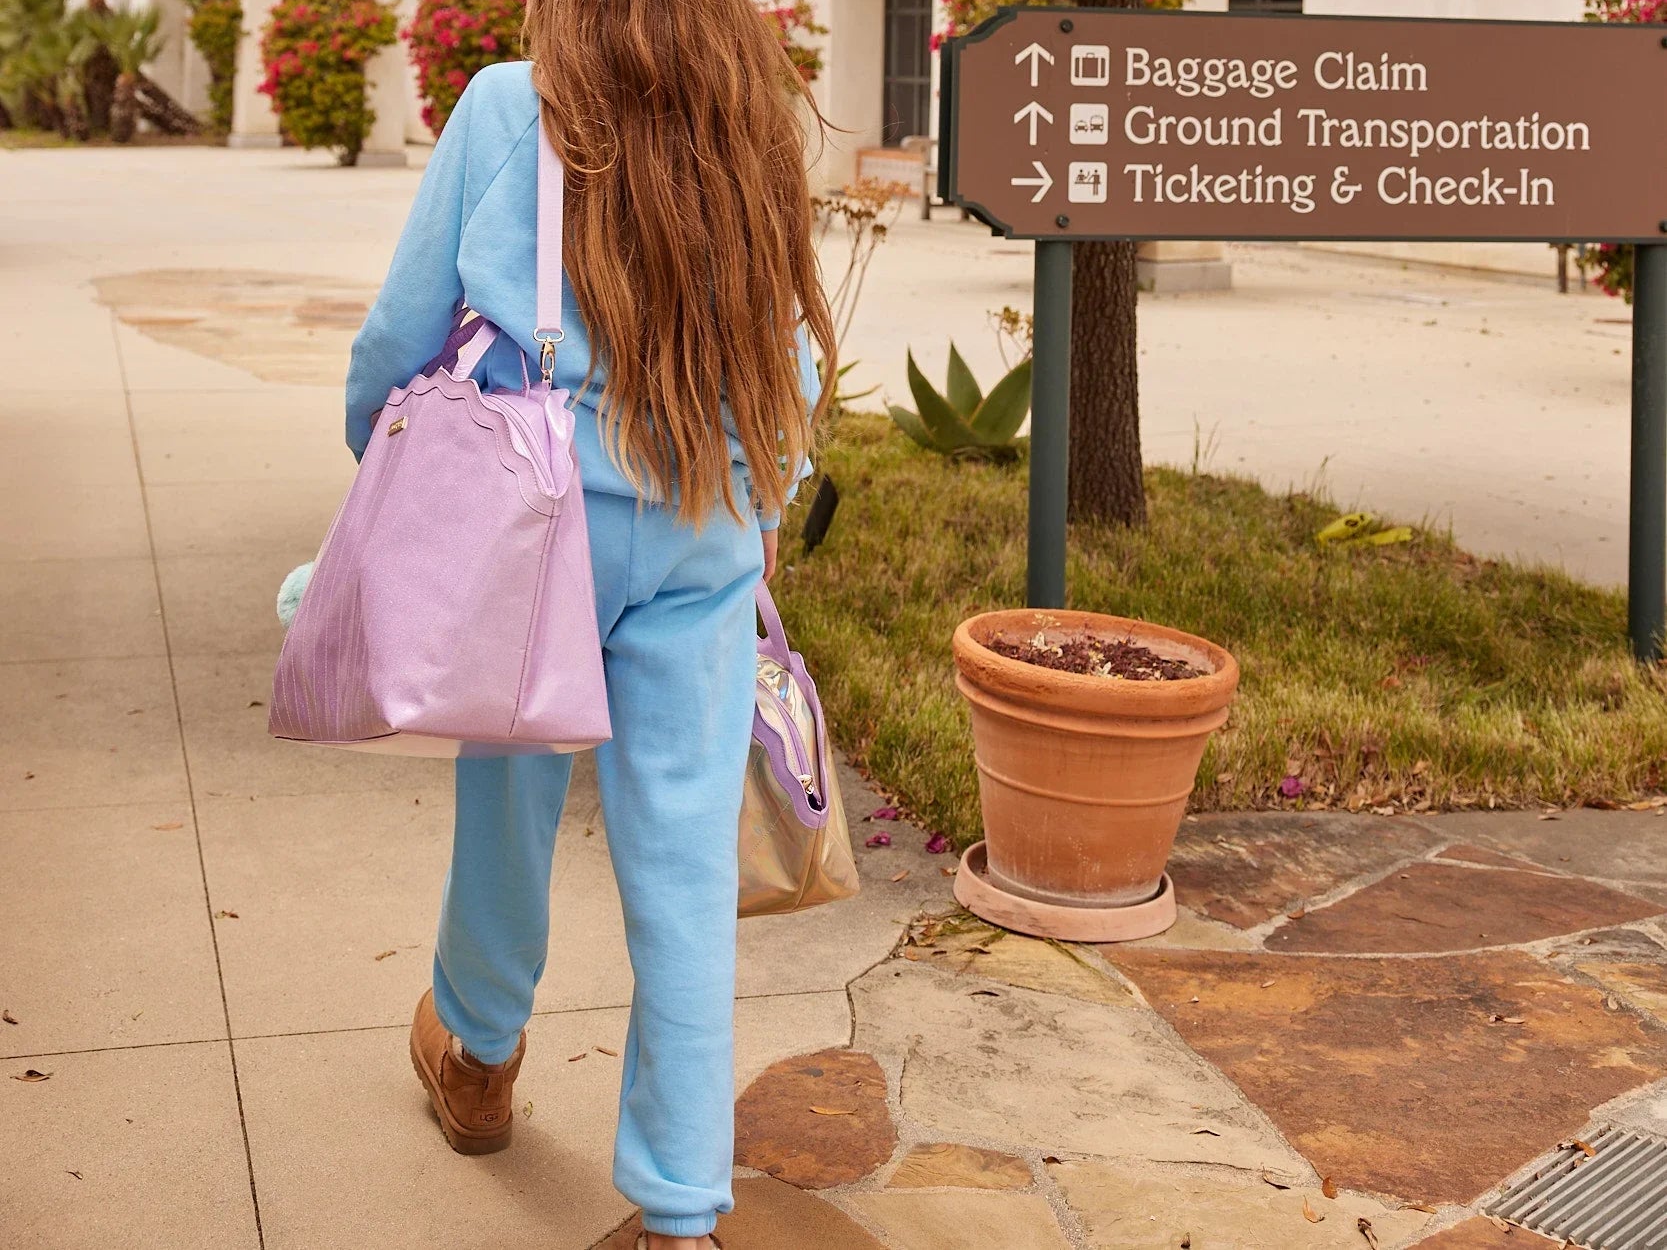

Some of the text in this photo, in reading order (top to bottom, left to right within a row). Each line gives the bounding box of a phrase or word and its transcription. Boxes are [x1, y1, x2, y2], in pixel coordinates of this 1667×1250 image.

[1125, 47, 1428, 98] Baggage Claim
[1124, 105, 1590, 158] Ground Transportation
[1123, 163, 1555, 214] Ticketing & Check-In
